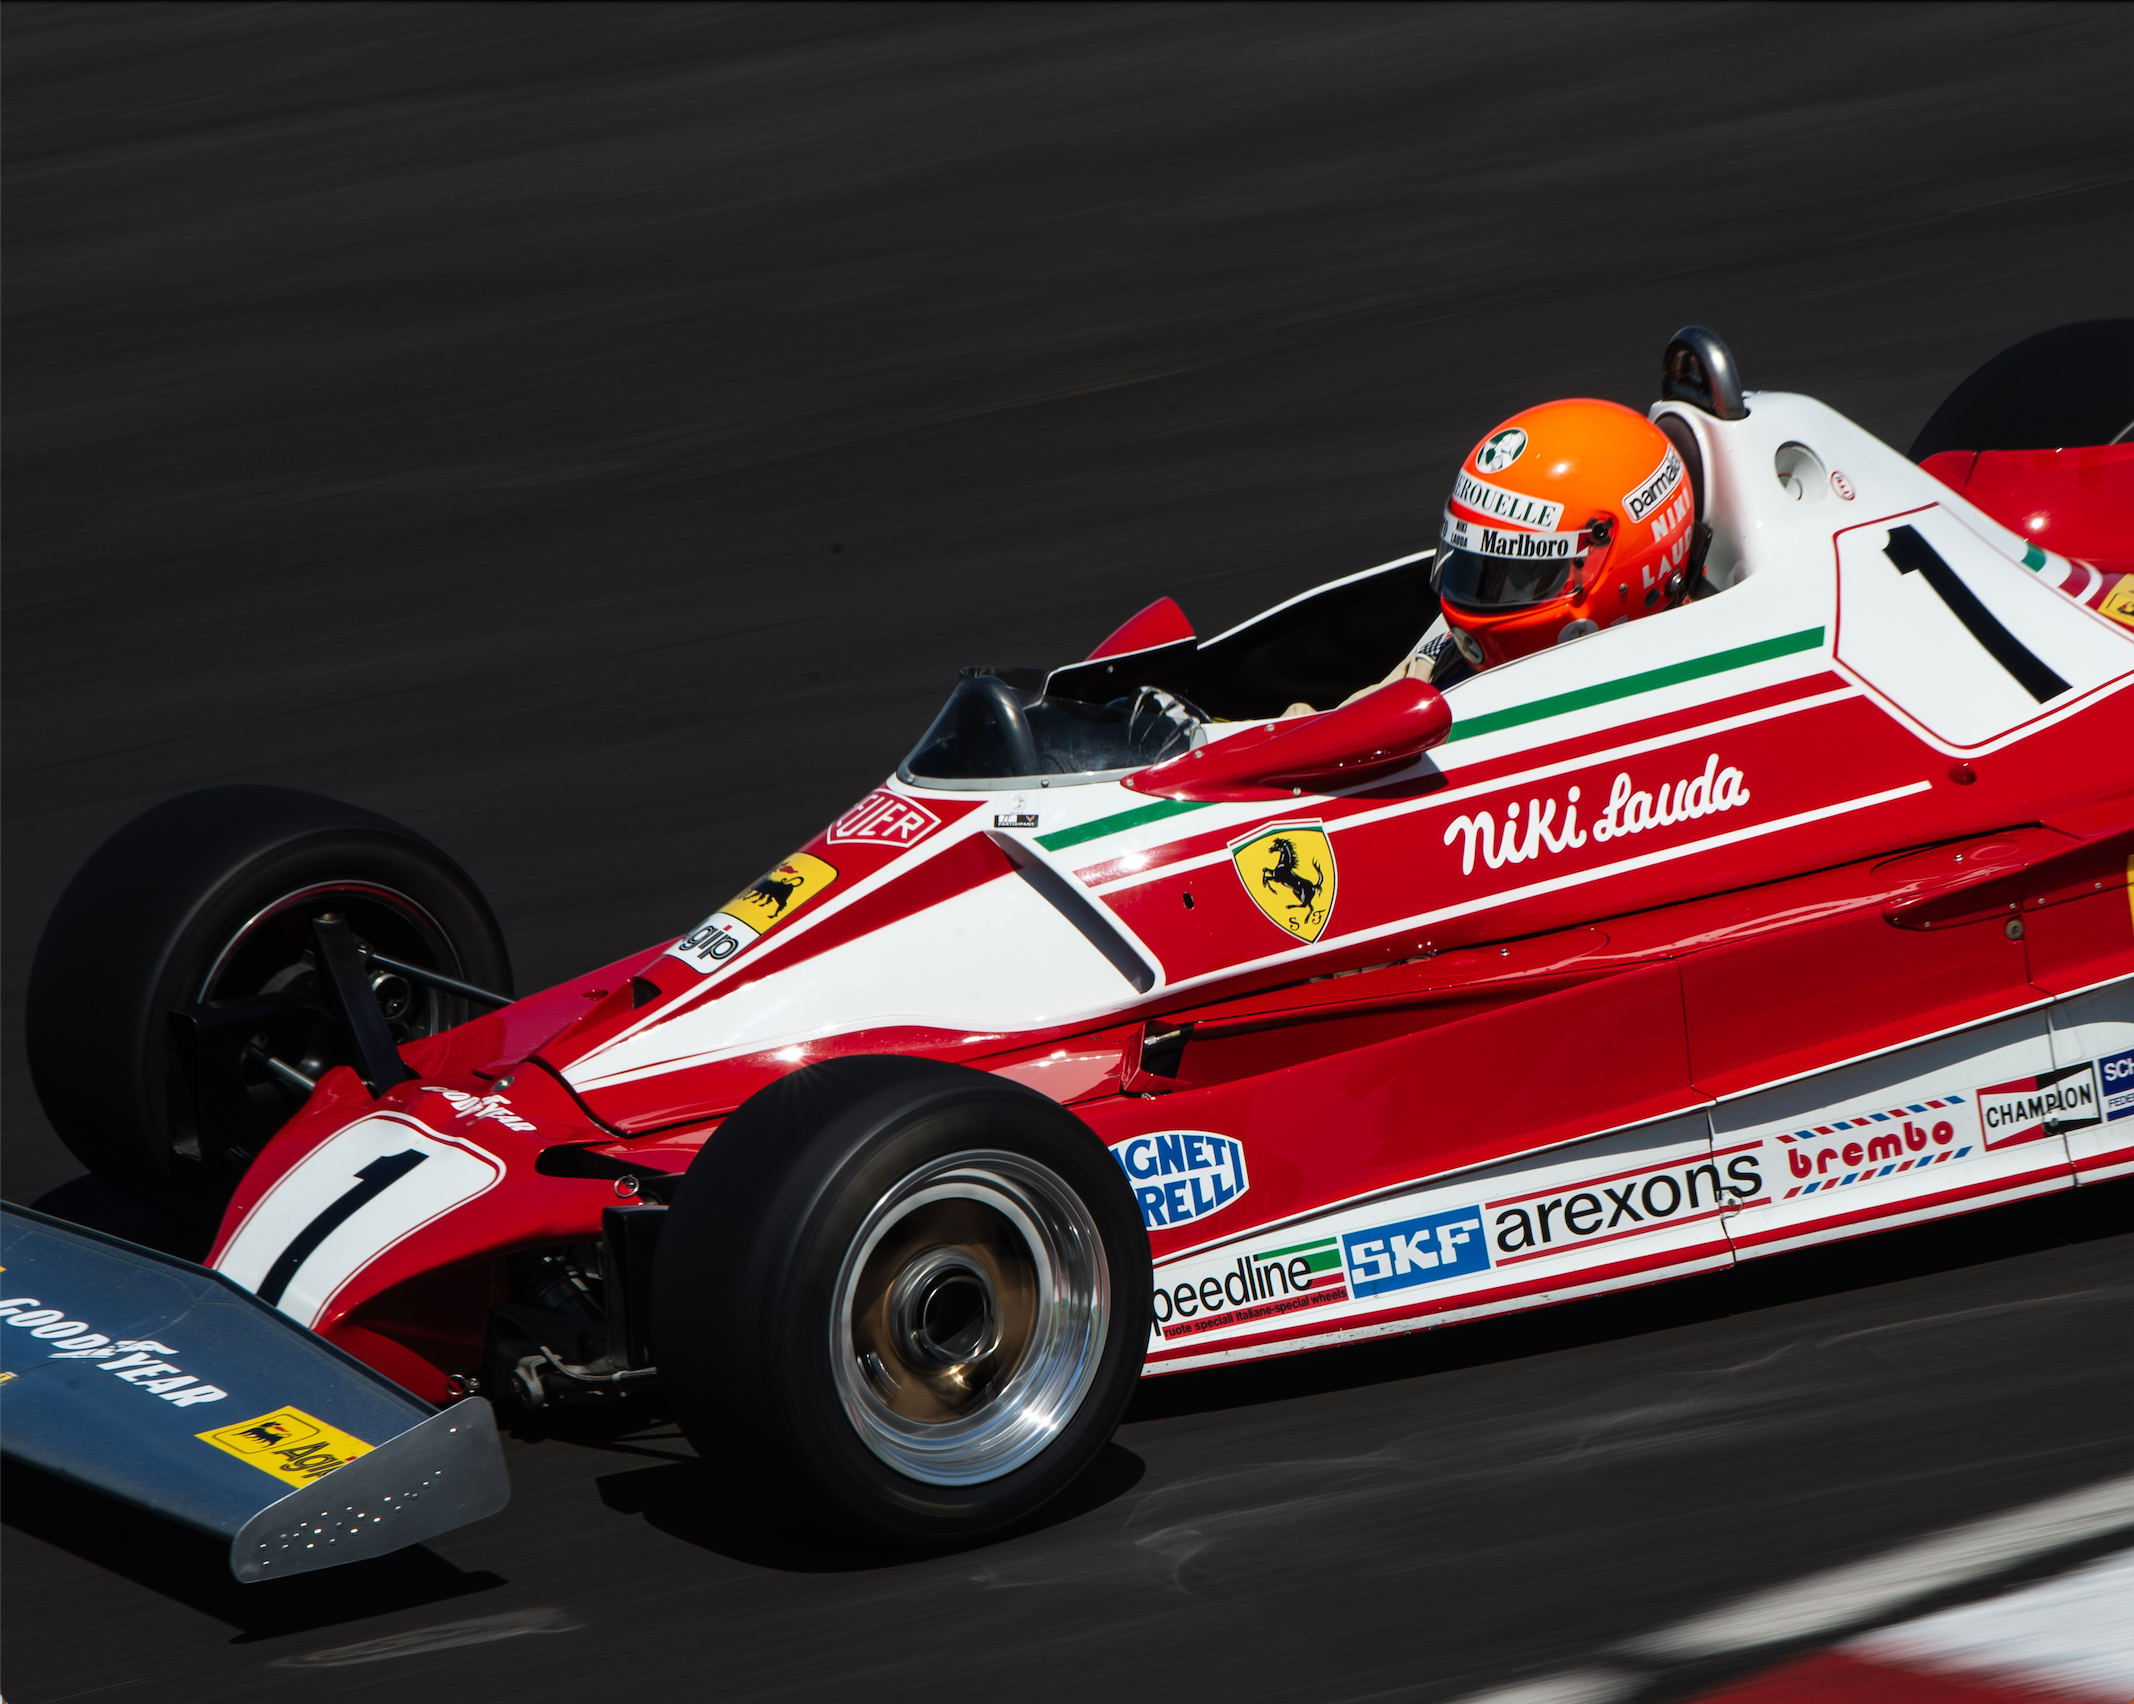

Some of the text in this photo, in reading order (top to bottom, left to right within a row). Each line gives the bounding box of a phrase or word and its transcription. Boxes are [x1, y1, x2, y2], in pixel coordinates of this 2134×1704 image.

[1480, 528, 1569, 557] Marlboro
[1651, 487, 1692, 544] NIKI
[1882, 524, 2074, 705] 1
[1592, 753, 1750, 842] Lauda
[678, 924, 738, 960] gip
[1288, 916, 1300, 931] S
[1986, 1083, 2092, 1128] CHAMPION
[1788, 1121, 1954, 1178] brembo
[256, 1148, 430, 1308] 1
[1495, 1155, 1762, 1252] arexons
[1351, 1218, 1480, 1285] SKF
[1164, 1324, 1193, 1338] ruote
[1194, 1312, 1234, 1332] speciali
[1311, 1288, 1347, 1305] wheels
